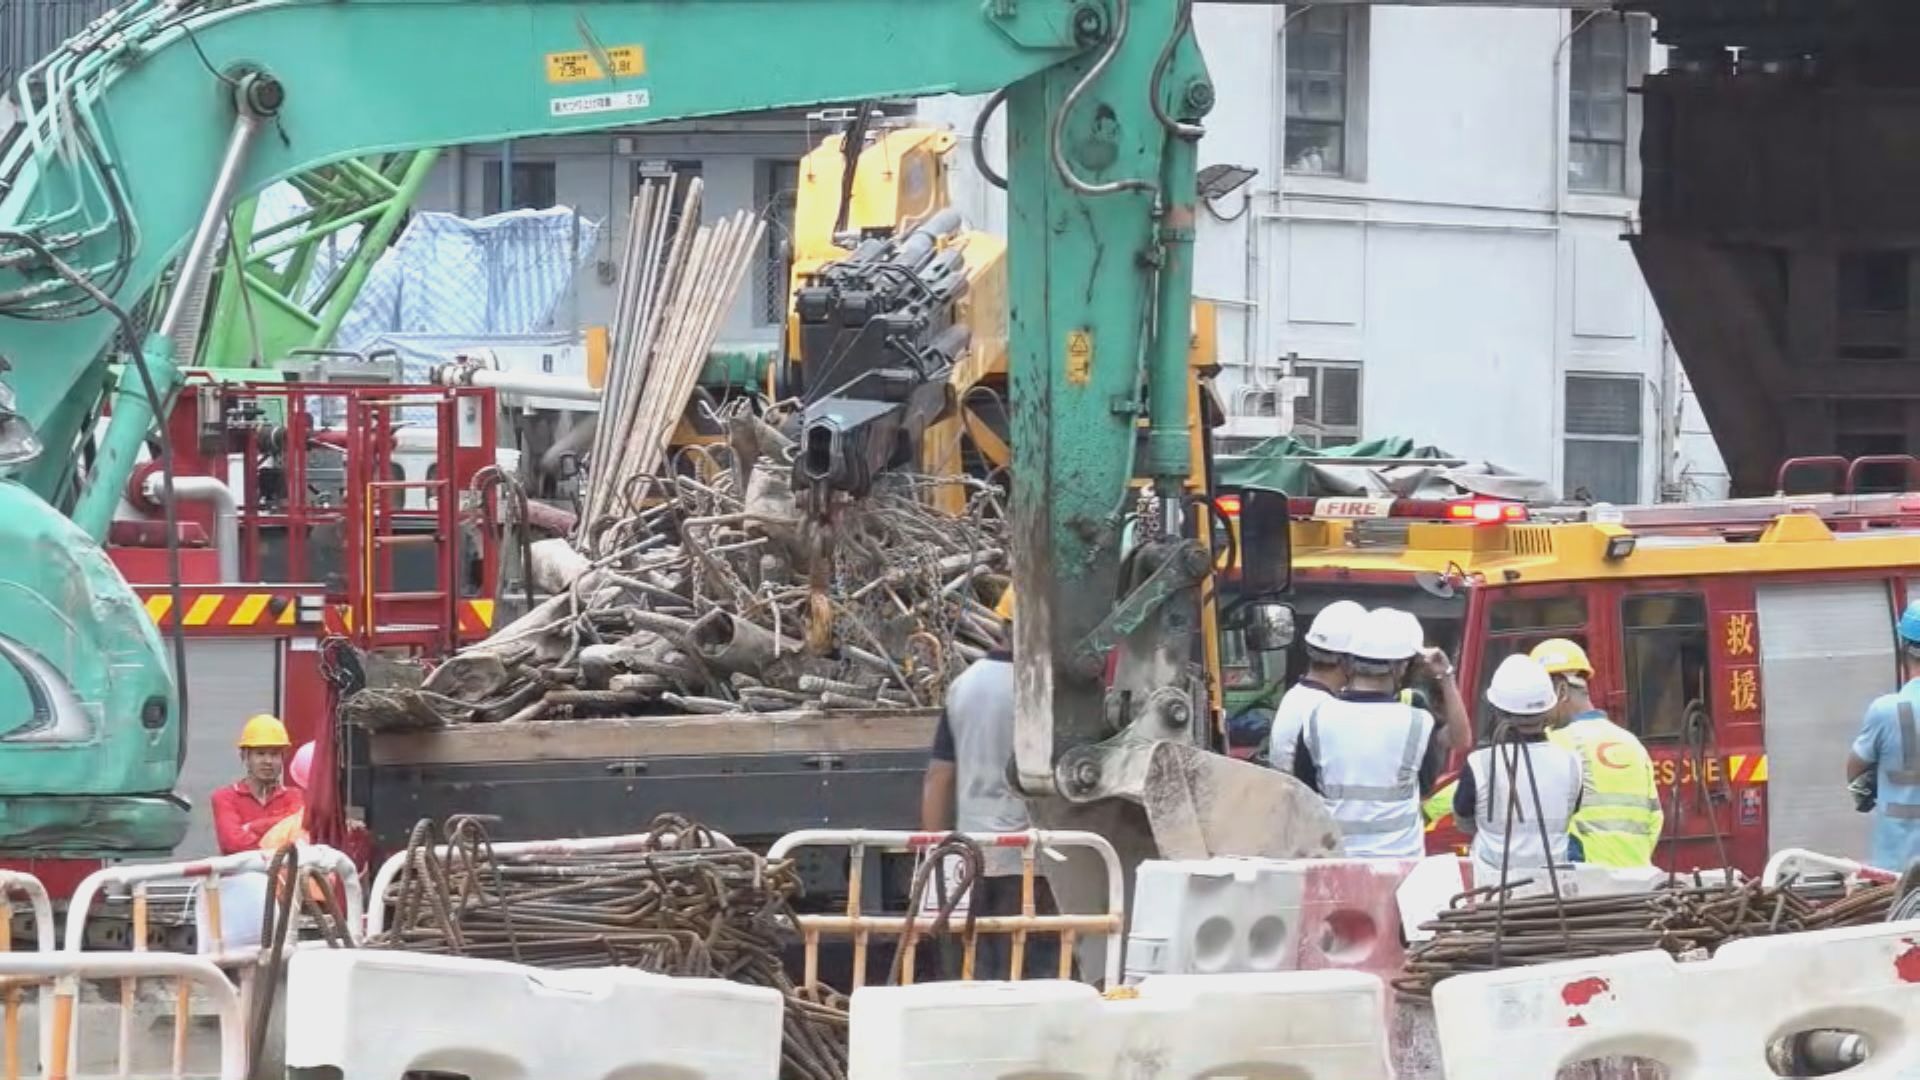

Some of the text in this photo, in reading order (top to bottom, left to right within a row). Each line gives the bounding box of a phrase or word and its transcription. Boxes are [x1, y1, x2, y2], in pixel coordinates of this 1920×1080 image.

[1327, 502, 1376, 515] FIRE
[1727, 613, 1757, 712] 救援
[1653, 758, 1720, 785] ESCUE
